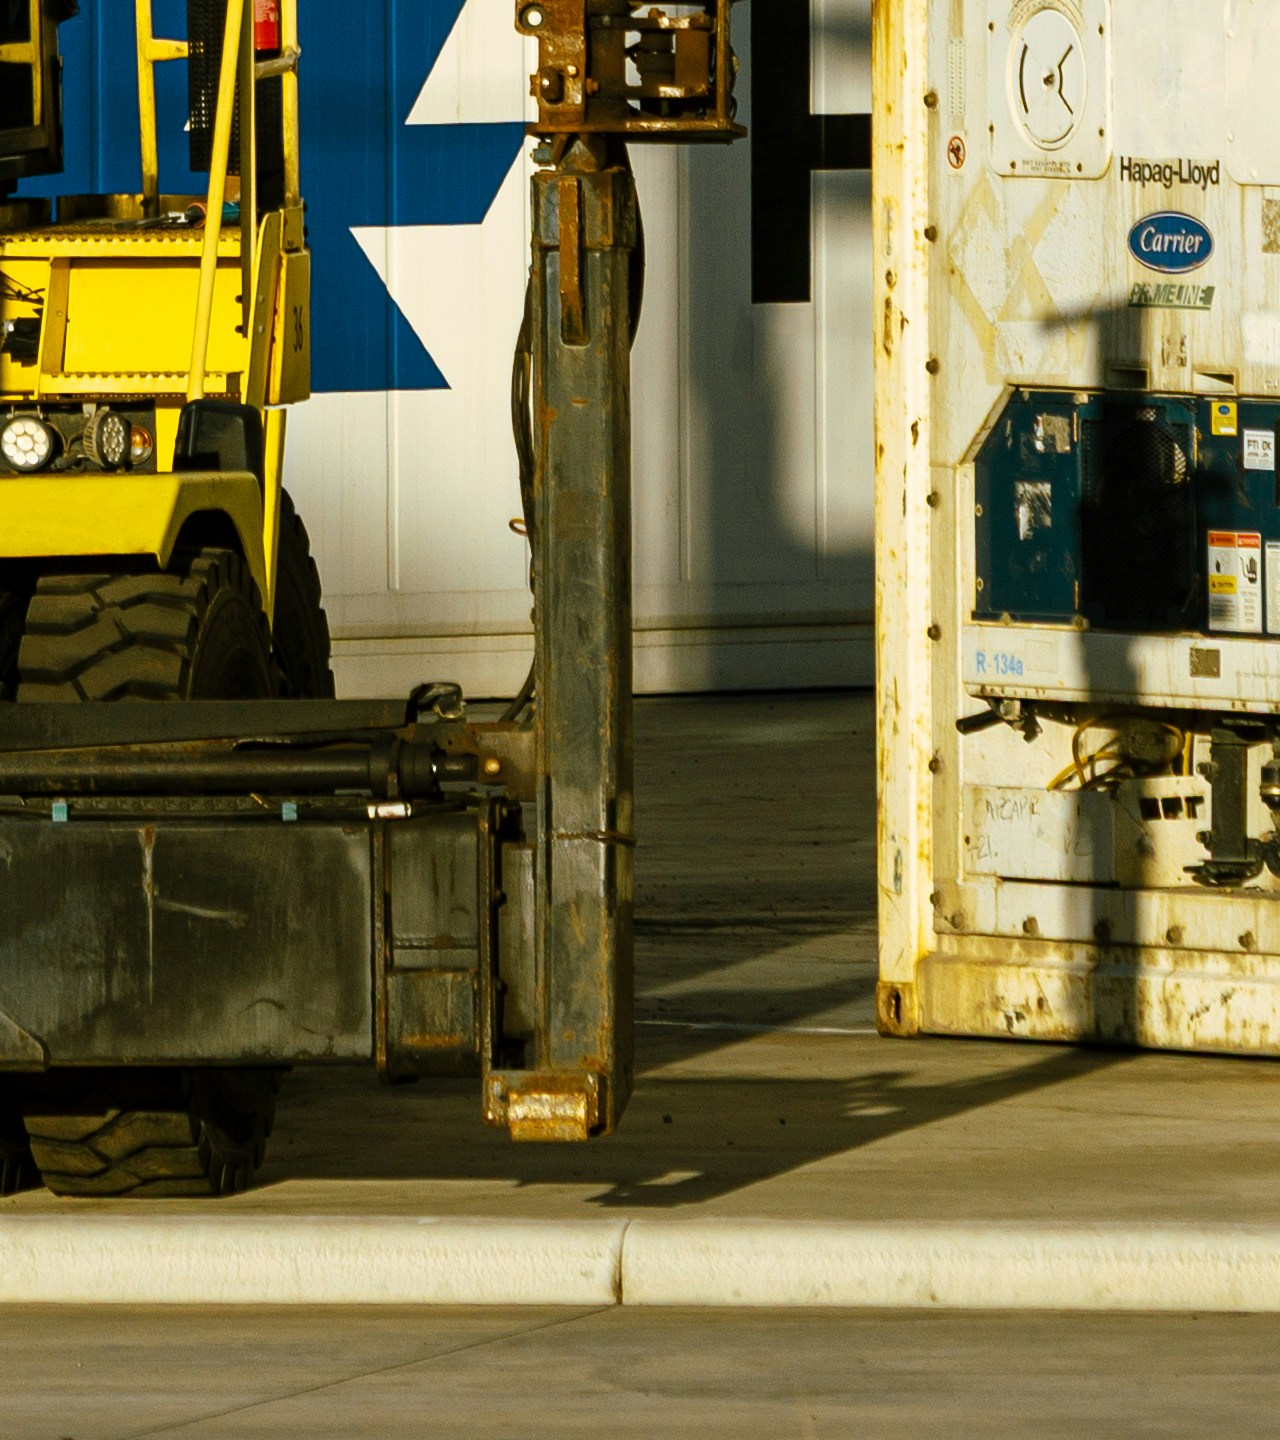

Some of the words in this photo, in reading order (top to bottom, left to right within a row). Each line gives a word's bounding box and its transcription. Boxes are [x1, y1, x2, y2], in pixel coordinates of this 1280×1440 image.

[1119, 155, 1221, 192] Hapag-Lloyd
[1140, 225, 1204, 255] Carrier
[975, 650, 1024, 676] R-134a
